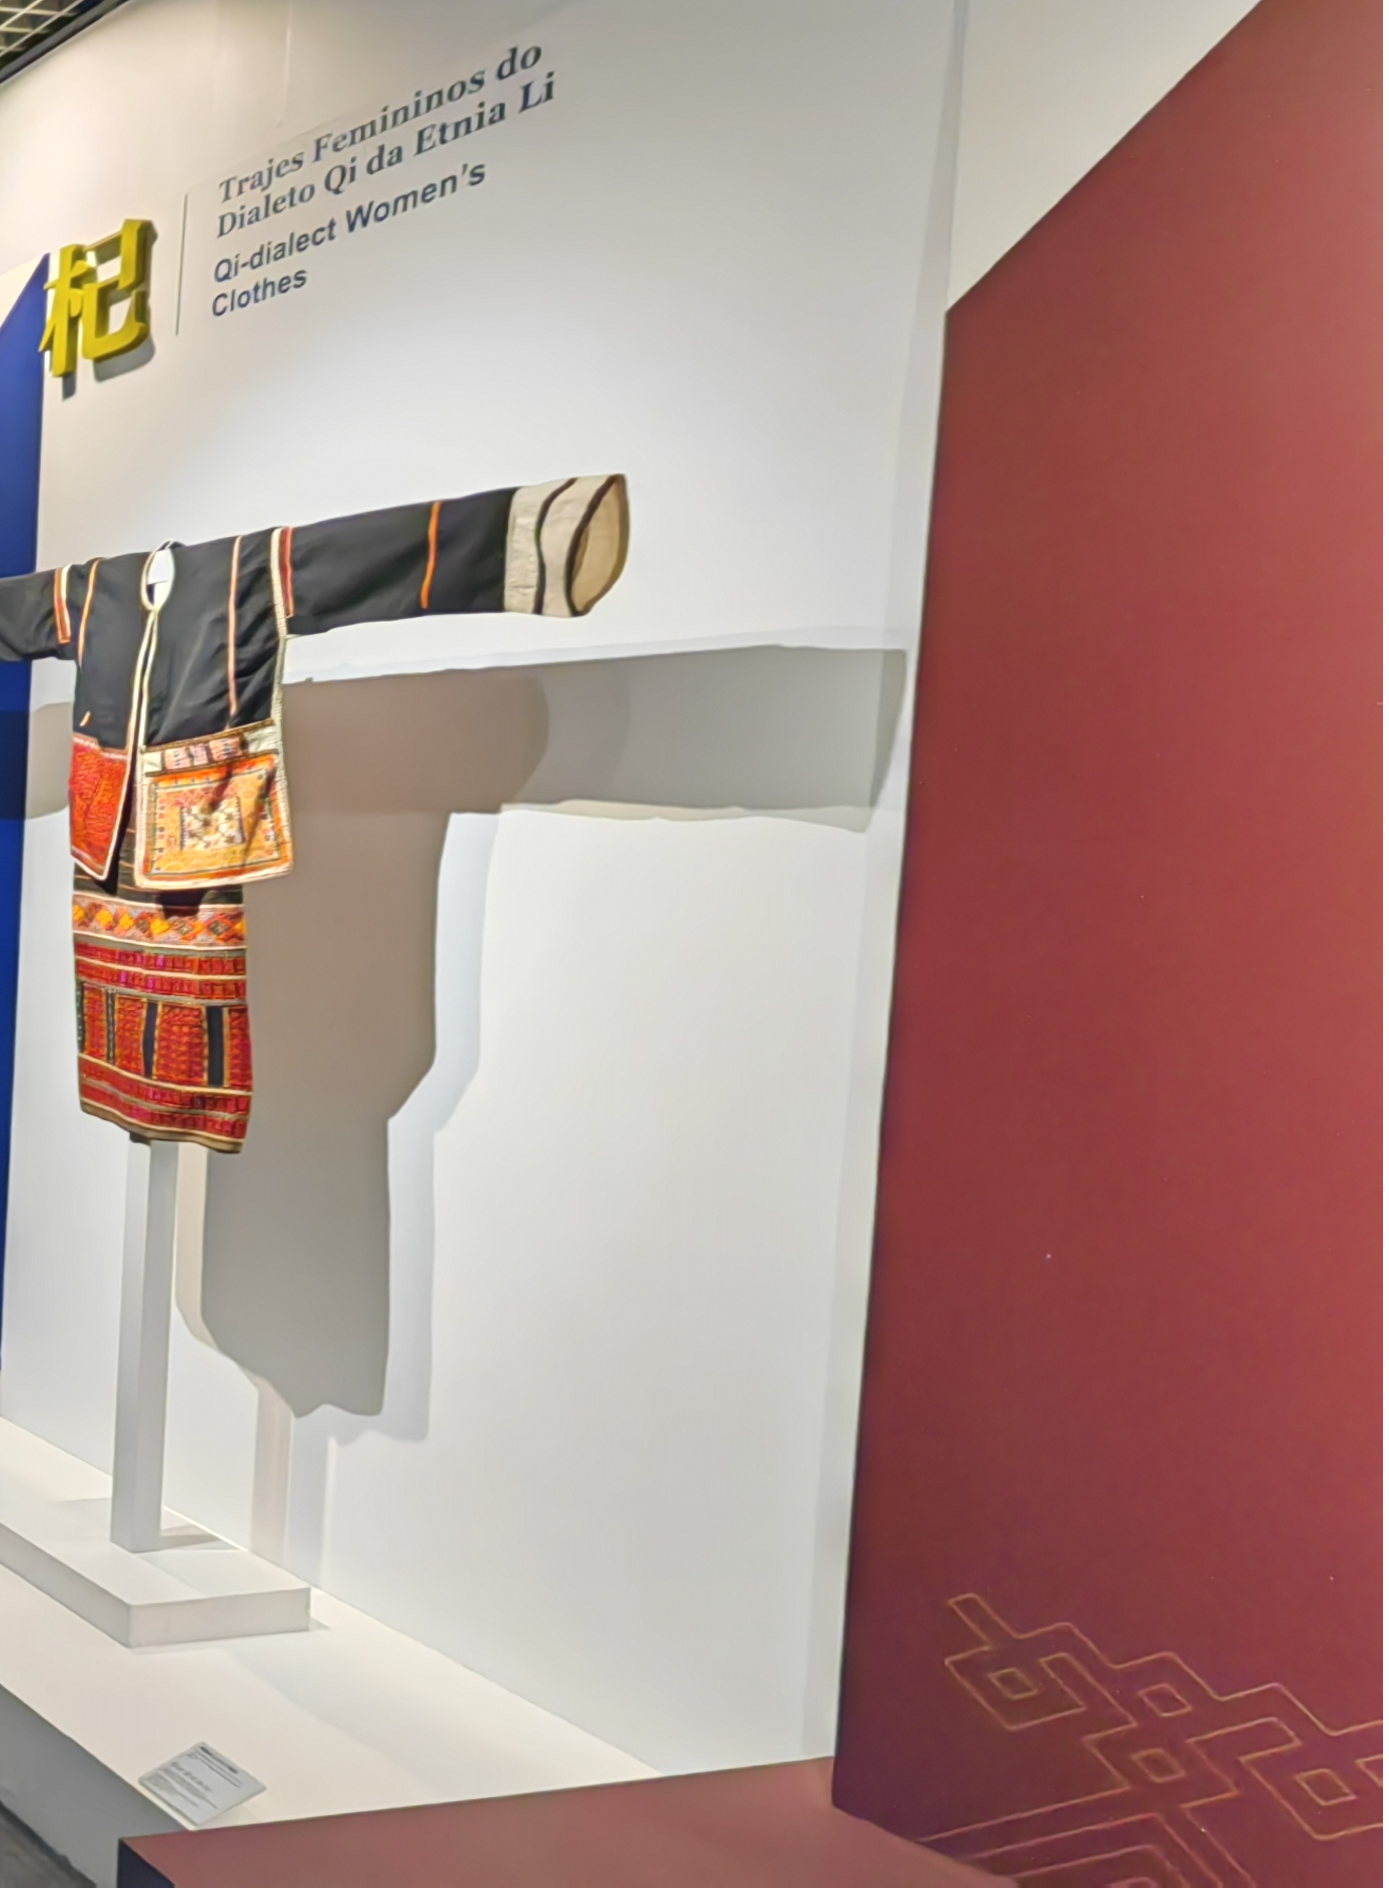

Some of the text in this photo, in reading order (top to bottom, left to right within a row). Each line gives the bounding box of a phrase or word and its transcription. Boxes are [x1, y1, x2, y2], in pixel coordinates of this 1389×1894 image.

[216, 70, 556, 239] Dialeto Qi da Etnia Li
[218, 45, 543, 204] Trajes Femininos do
[37, 218, 158, 379] 杞
[211, 269, 309, 318] Clothes
[213, 162, 487, 284] Qi-dialect Women's
